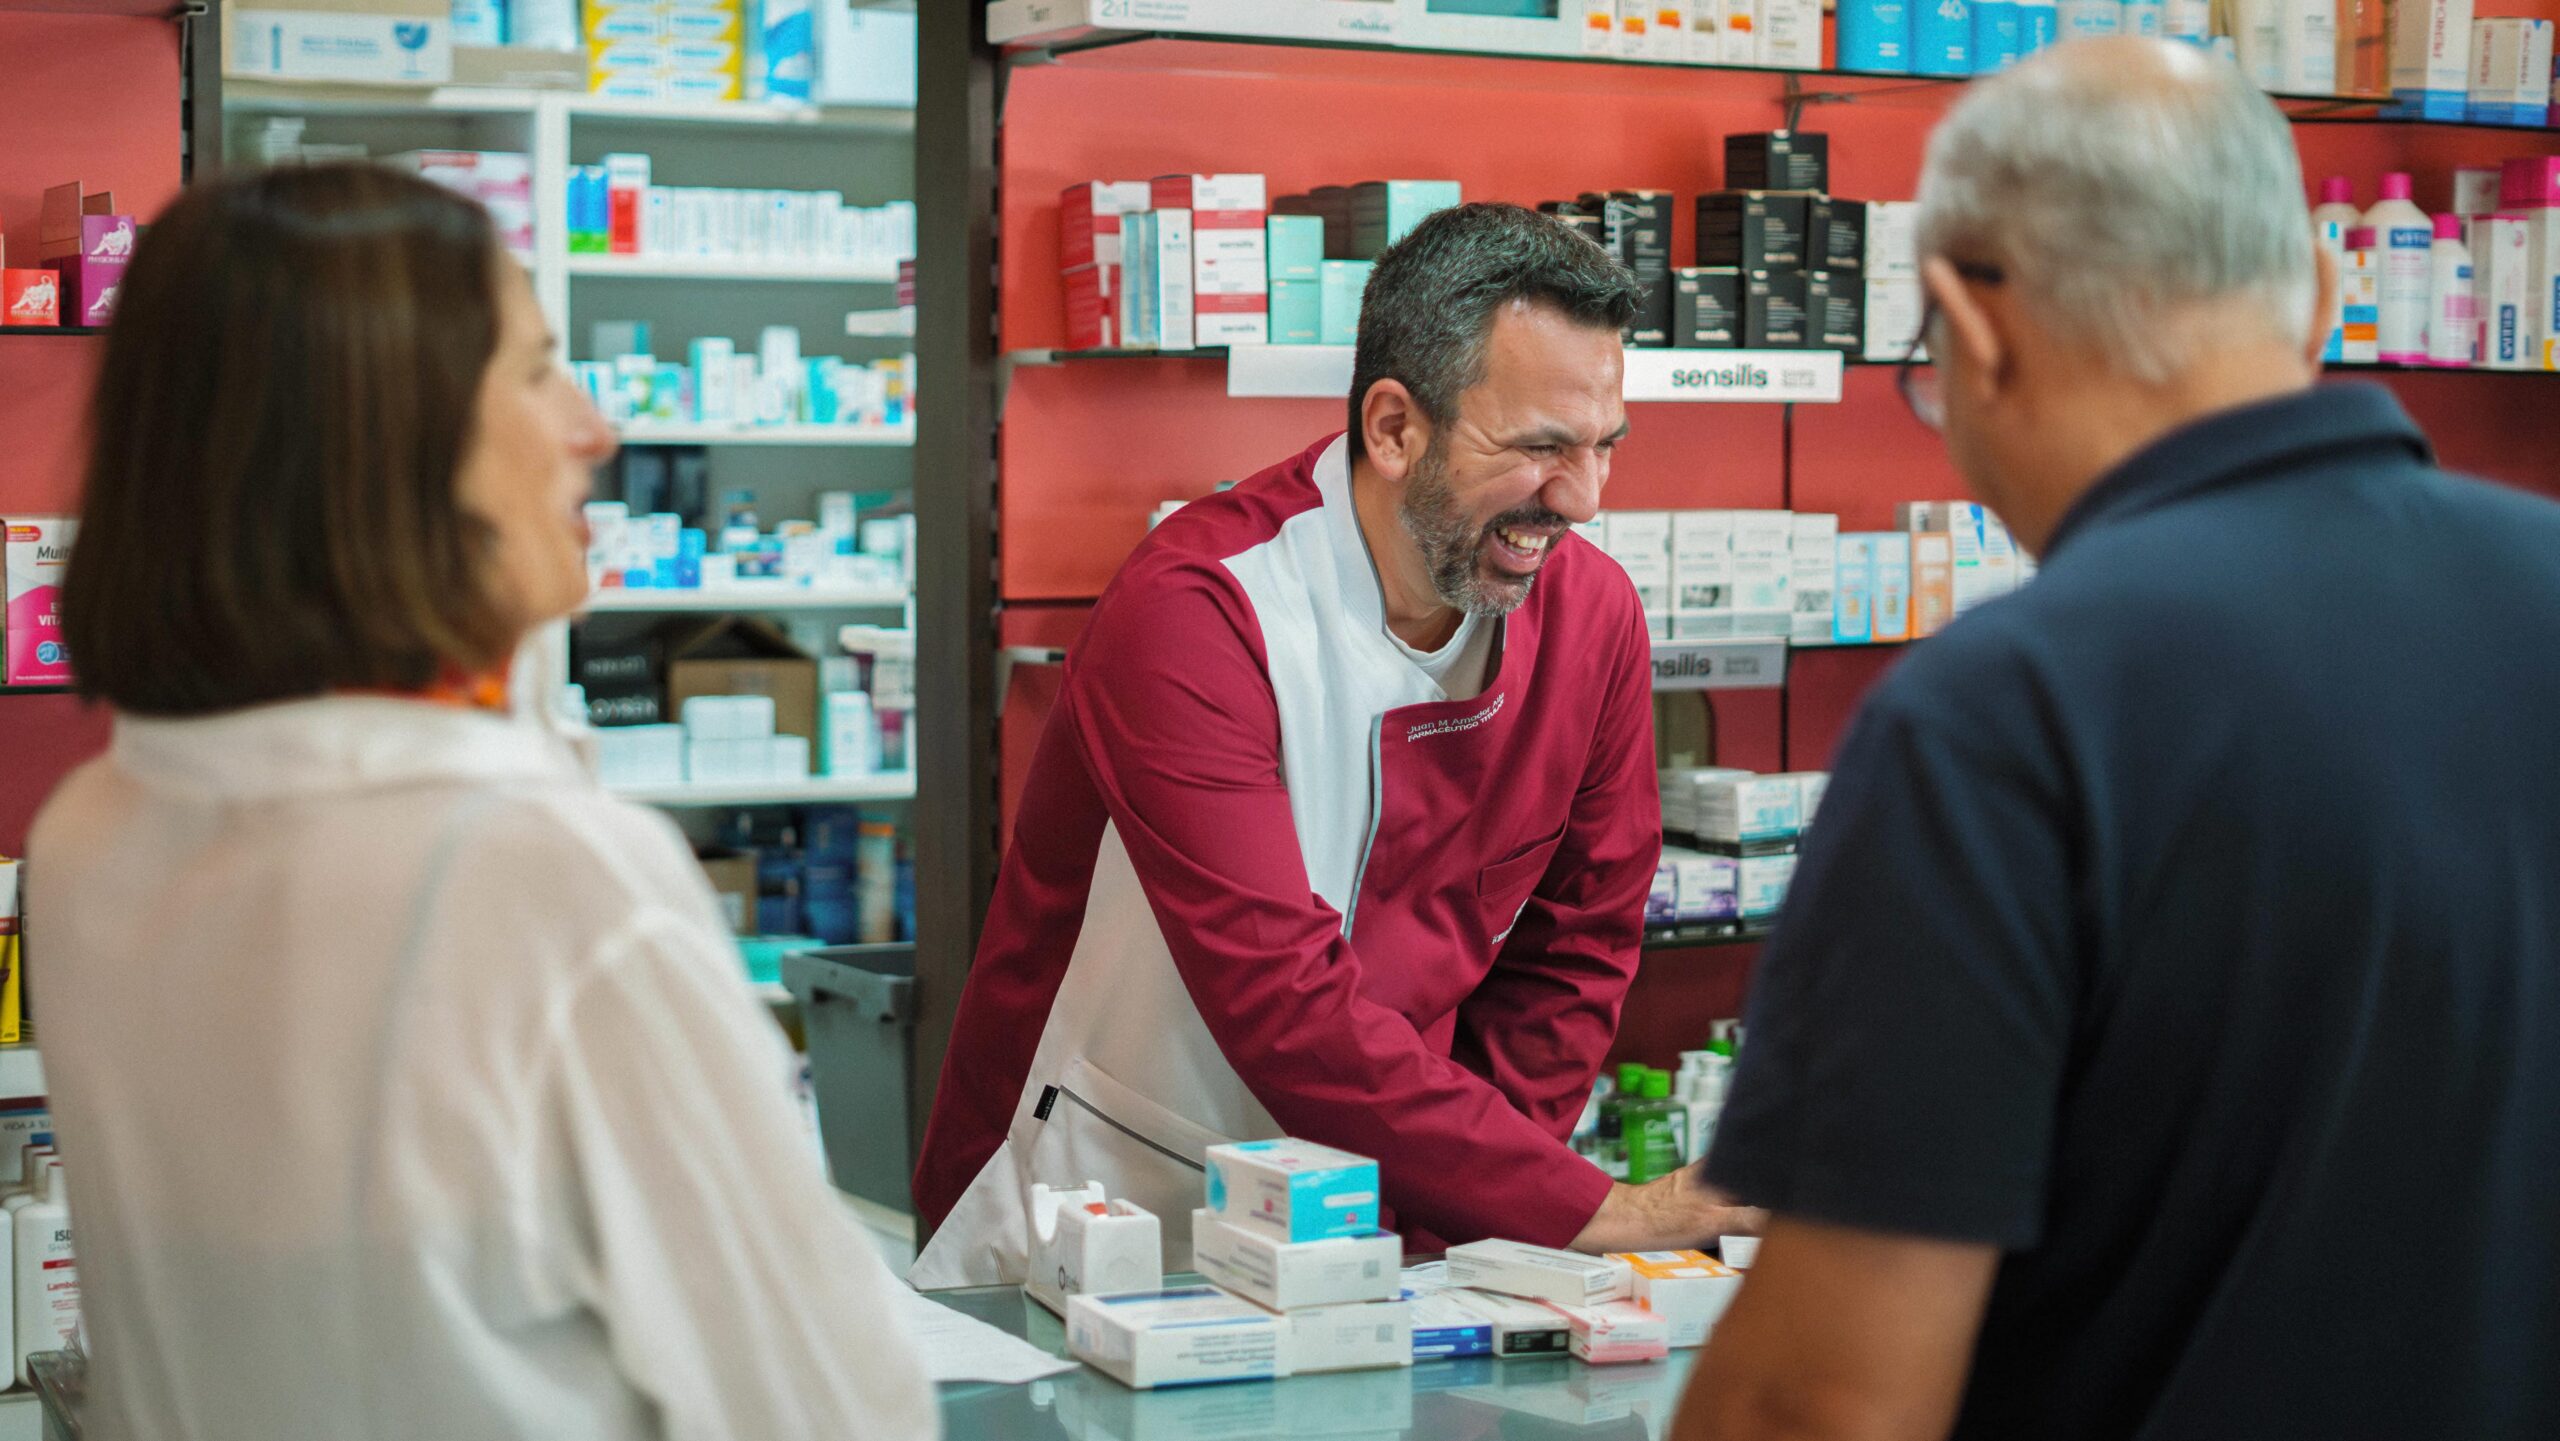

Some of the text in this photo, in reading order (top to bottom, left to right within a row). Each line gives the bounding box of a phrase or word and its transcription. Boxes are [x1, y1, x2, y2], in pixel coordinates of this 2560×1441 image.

[1671, 362, 1768, 388] sensilis
[1407, 722, 1435, 734] Juan
[1452, 705, 1491, 725] Amador
